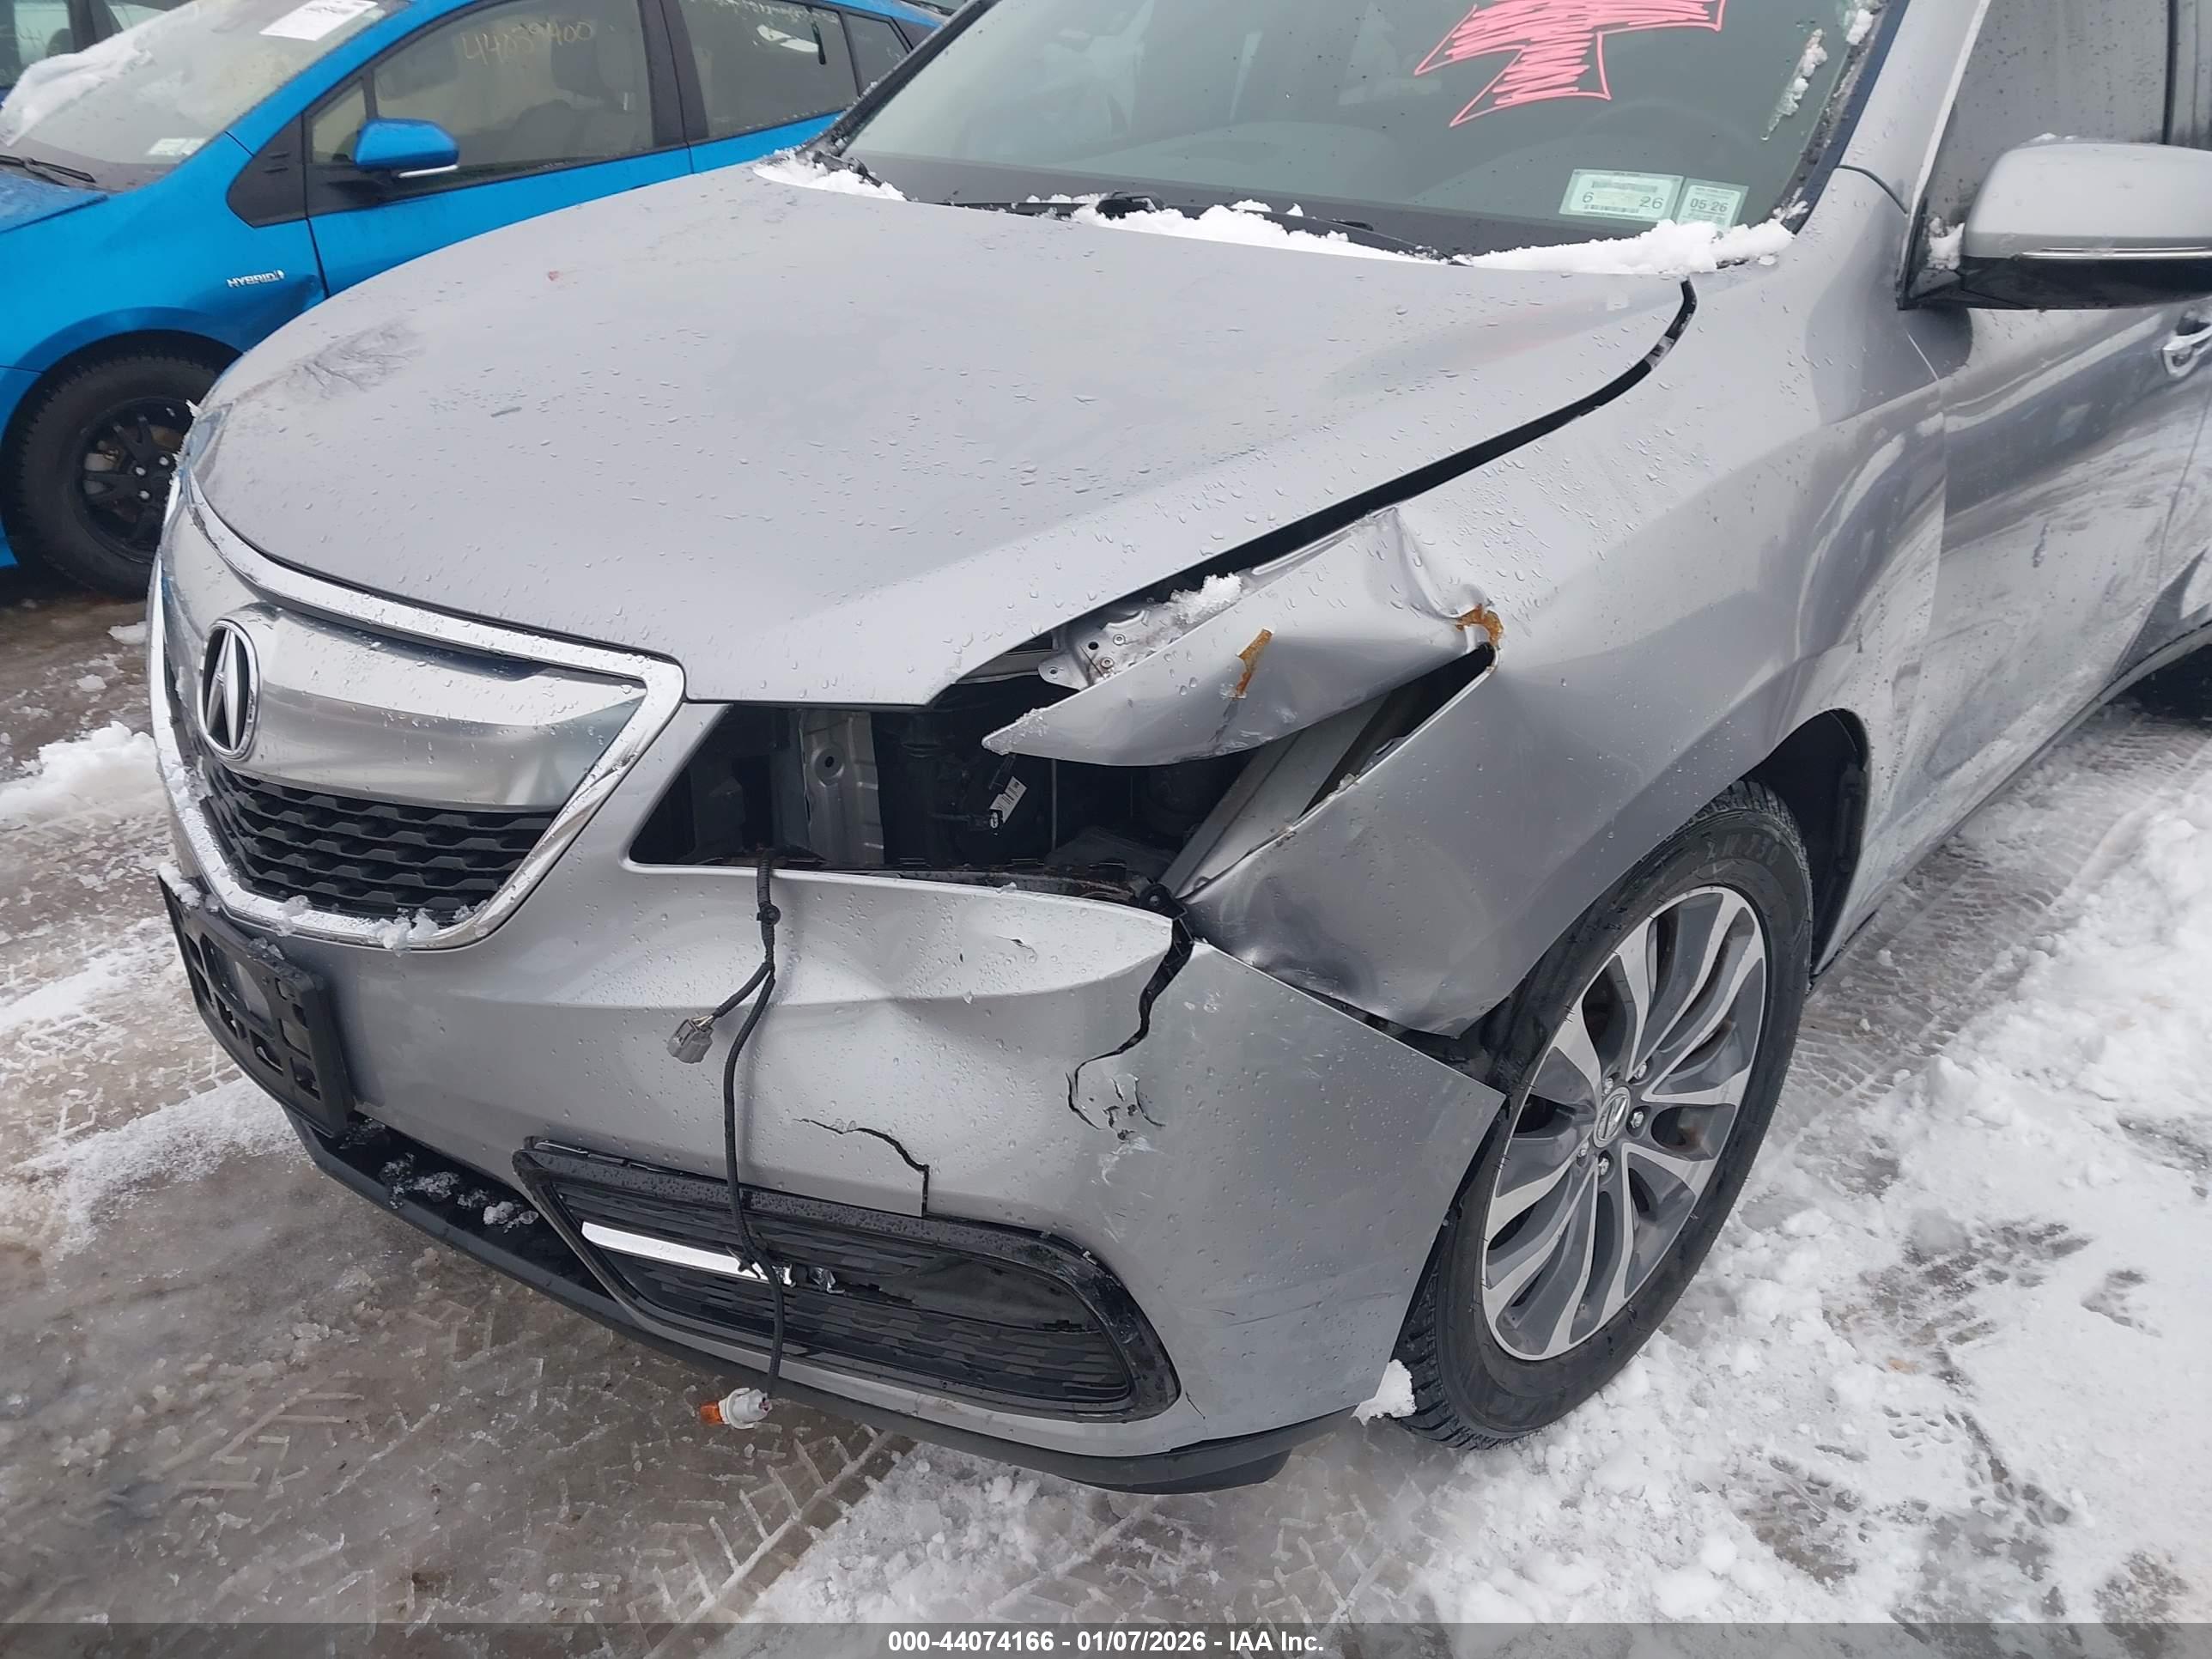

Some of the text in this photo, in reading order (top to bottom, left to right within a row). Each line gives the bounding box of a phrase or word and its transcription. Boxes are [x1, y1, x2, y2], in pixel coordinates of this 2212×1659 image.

[1583, 191, 1595, 204] 6
[1639, 195, 1664, 210] 26
[226, 270, 276, 289] HYBRID
